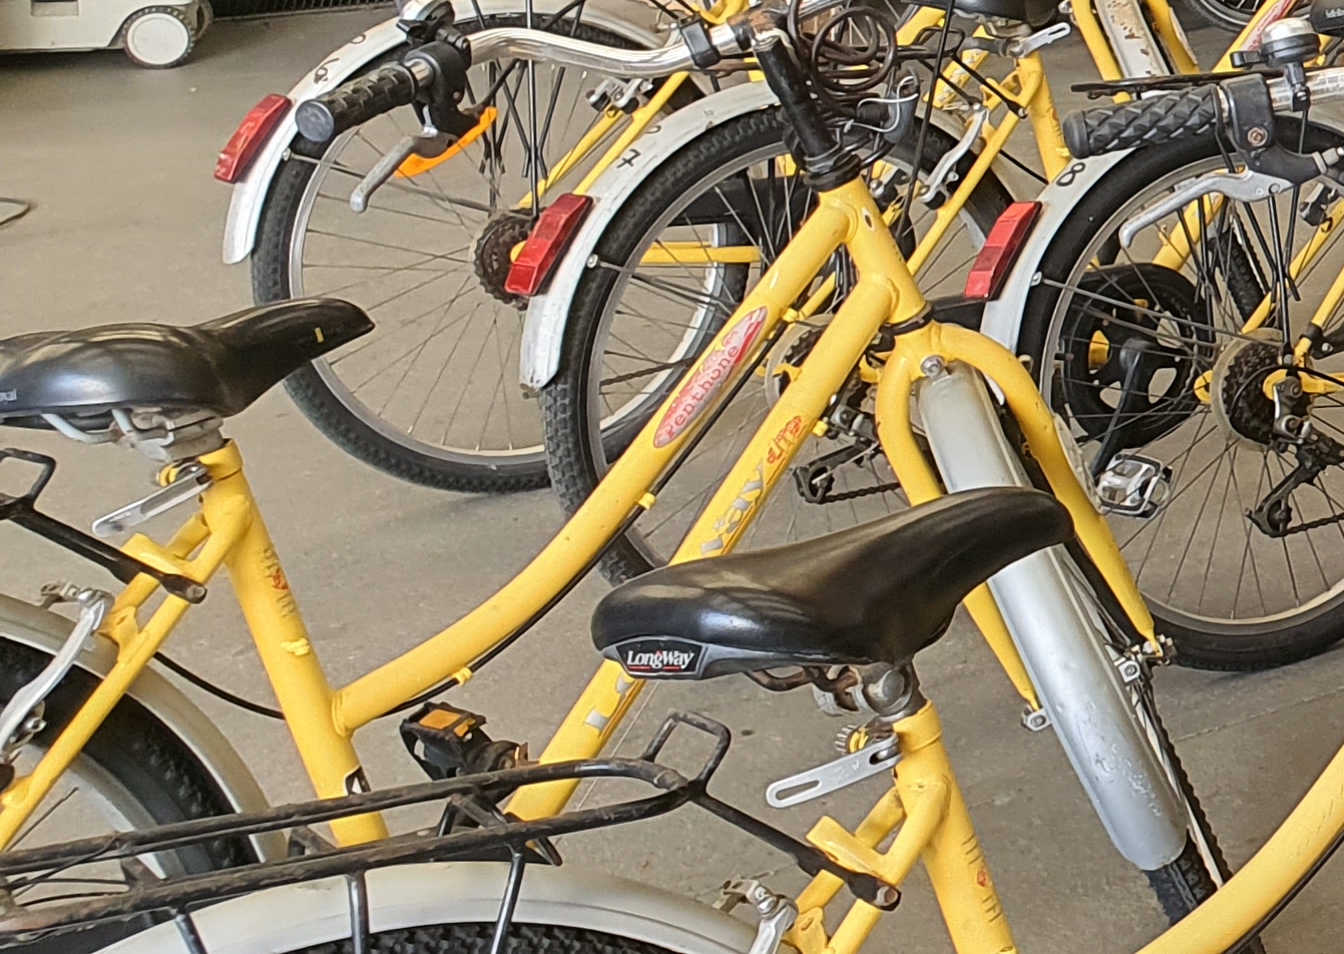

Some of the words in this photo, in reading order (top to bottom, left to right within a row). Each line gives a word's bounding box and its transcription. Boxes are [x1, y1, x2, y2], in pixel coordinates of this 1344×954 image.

[616, 148, 641, 169] 7
[1055, 161, 1086, 187] 8
[626, 648, 695, 670] LongWay
